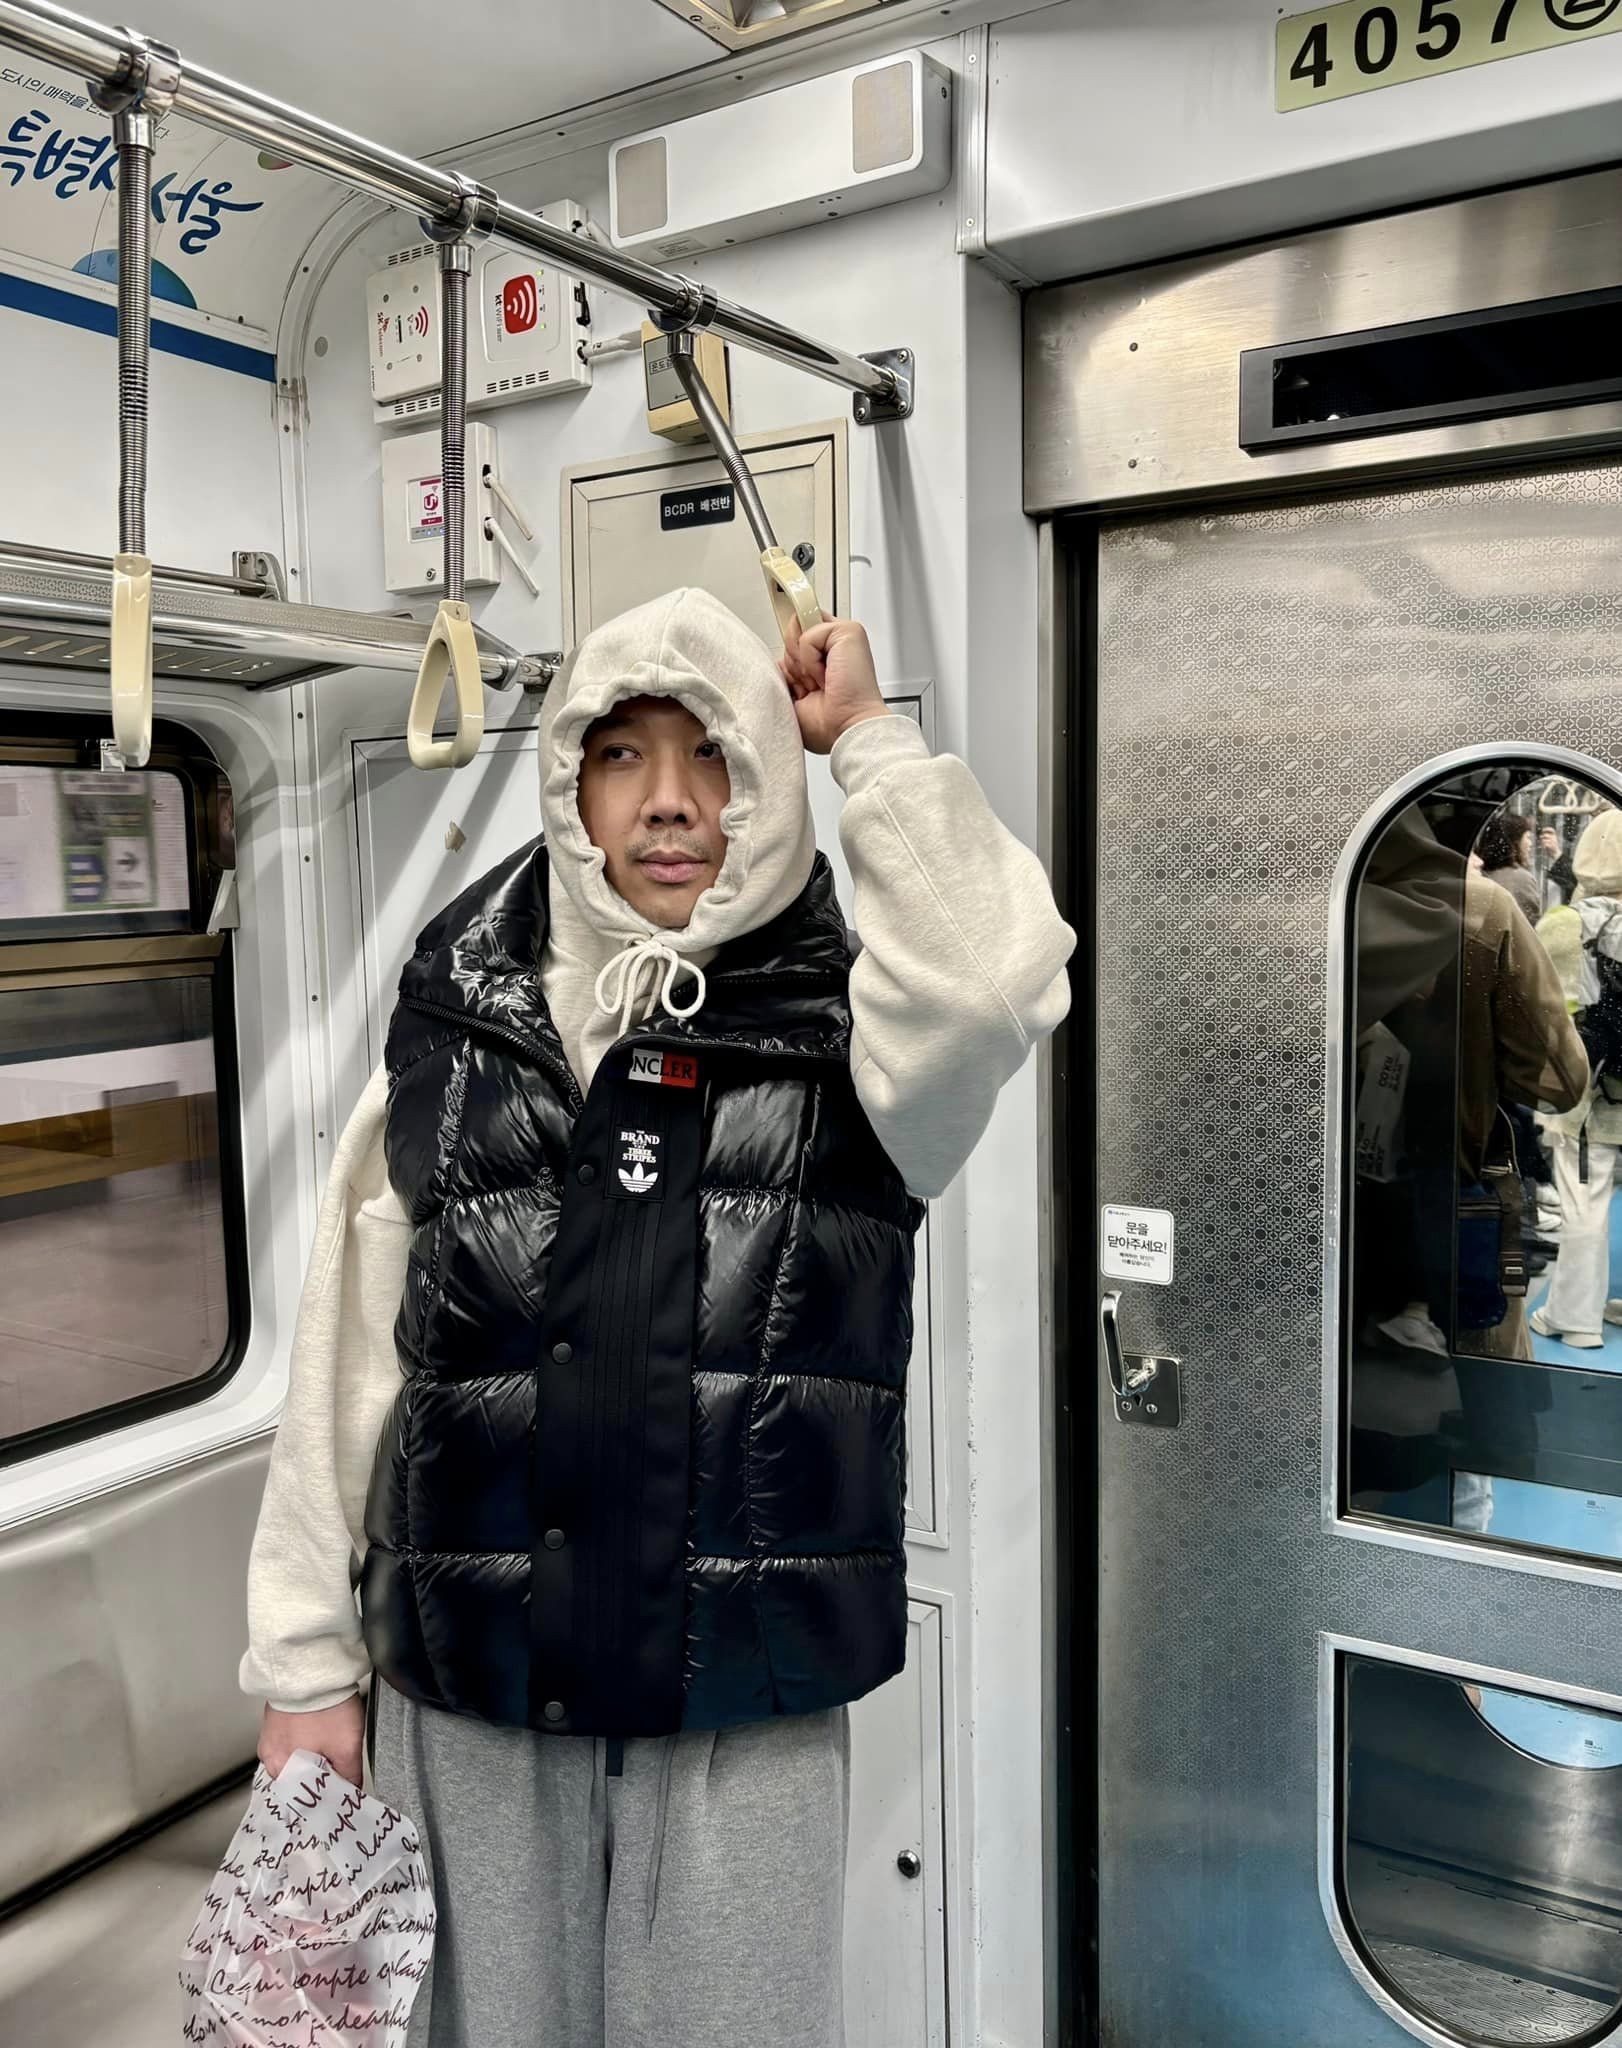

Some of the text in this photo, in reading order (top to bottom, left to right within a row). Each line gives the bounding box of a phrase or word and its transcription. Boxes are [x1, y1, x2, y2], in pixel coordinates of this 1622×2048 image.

[1290, 0, 1519, 88] 4057
[0, 68, 89, 109] 도시의 매력을
[150, 172, 264, 254] 서울
[664, 495, 731, 518] BCDR 배전반
[620, 1131, 661, 1145] BRAND
[622, 1153, 657, 1164] STRIPES
[1126, 1221, 1149, 1237] 문을
[1107, 1235, 1168, 1255] 닫아주세요!
